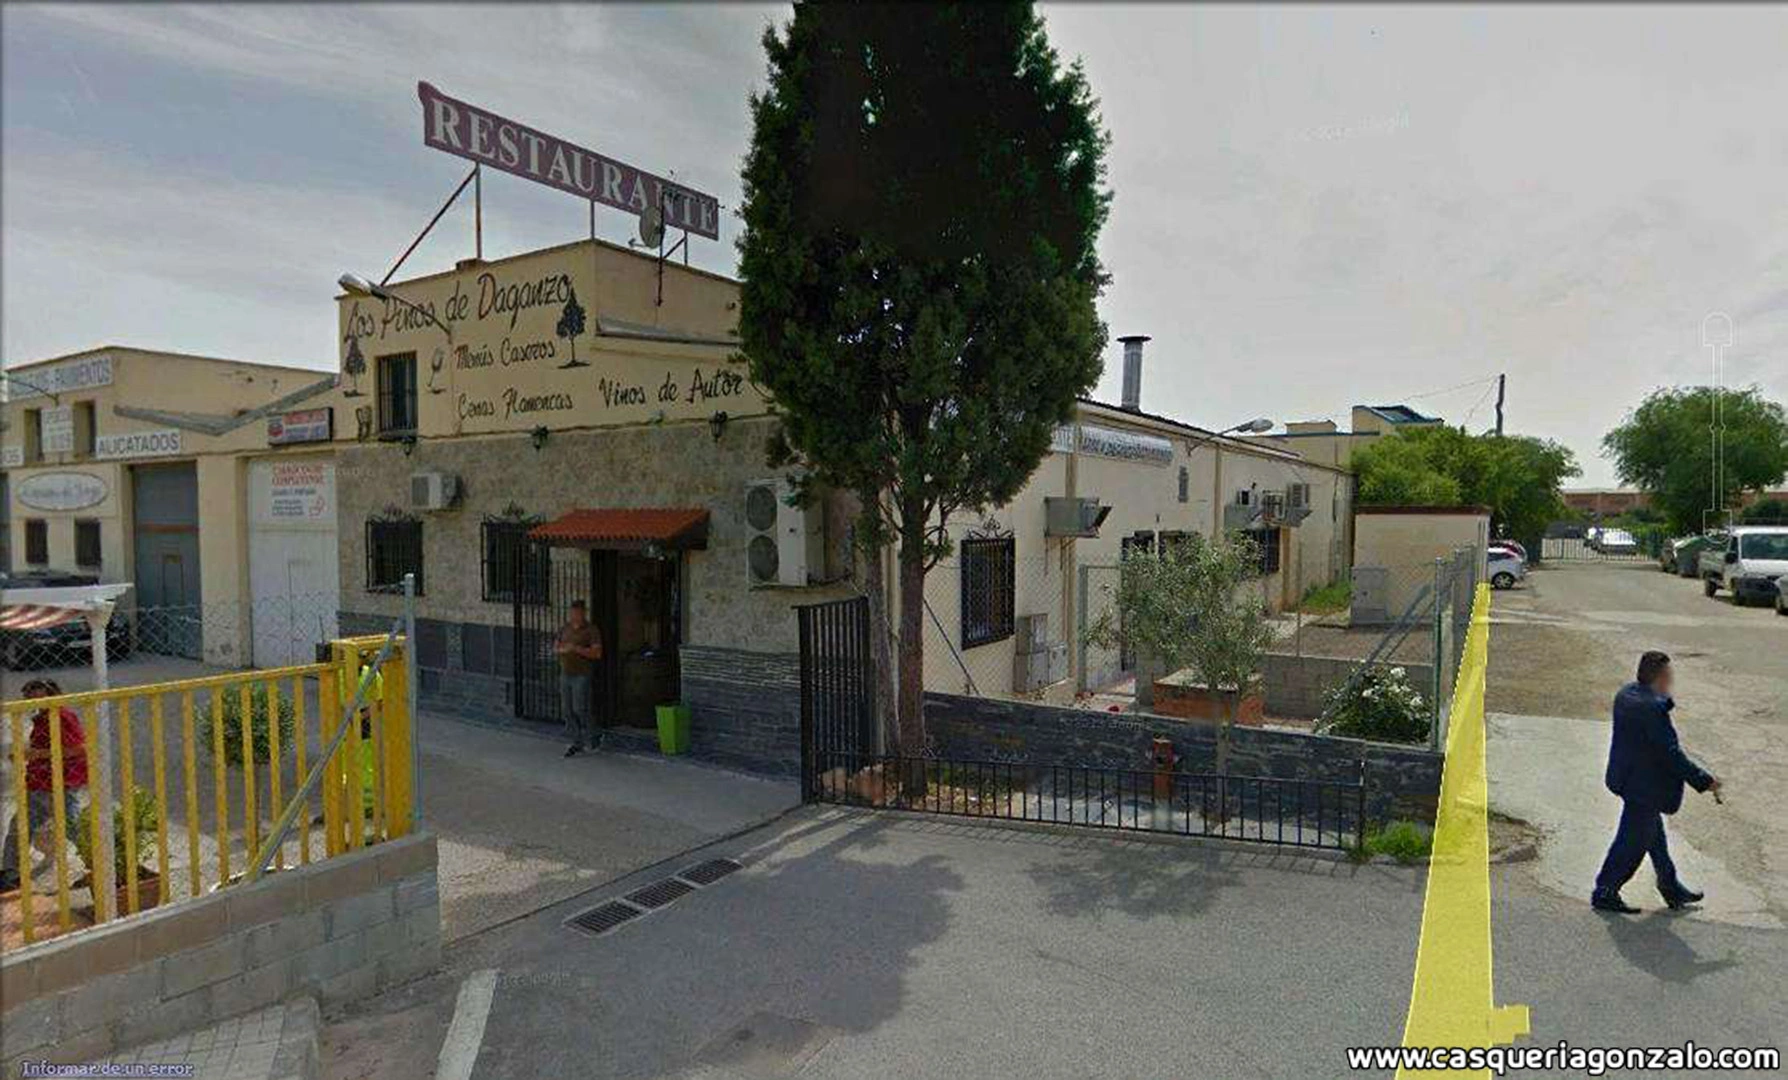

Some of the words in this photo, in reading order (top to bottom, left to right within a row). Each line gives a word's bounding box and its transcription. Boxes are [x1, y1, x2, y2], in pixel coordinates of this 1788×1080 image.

[431, 99, 717, 233] RESTAURANTE
[343, 301, 375, 343] Los
[382, 294, 435, 340] Pinos
[445, 279, 469, 321] de
[477, 273, 571, 333] Daganzo
[500, 337, 555, 367] Caseros
[458, 394, 496, 420] Cenas
[502, 388, 573, 421] Flamencas
[598, 377, 646, 409] Vinos
[658, 370, 679, 402] de
